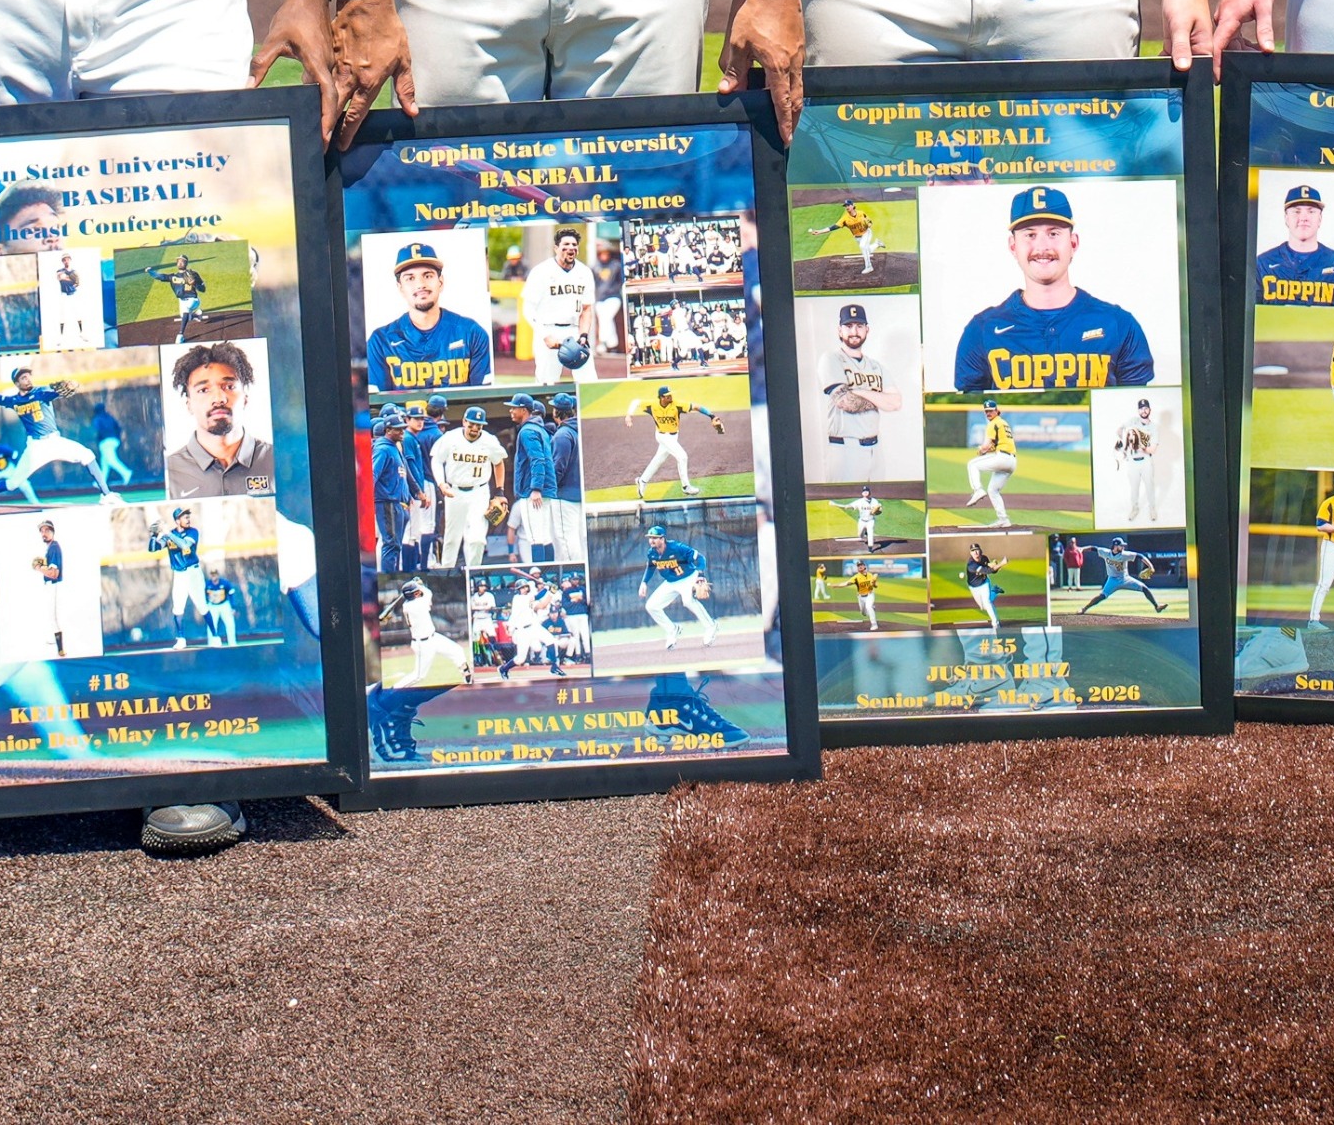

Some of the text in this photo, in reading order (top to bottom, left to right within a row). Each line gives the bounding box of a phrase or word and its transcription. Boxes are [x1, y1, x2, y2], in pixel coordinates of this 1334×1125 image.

[837, 98, 1126, 125] Coppin State University
[915, 127, 1052, 148] BASEBALL
[399, 134, 690, 167] Coppin State University
[26, 159, 90, 180] State
[99, 151, 230, 175] University
[480, 166, 618, 189] BASEBALL
[853, 157, 1115, 177] Northeast Conference
[62, 182, 203, 207] BASEBALL
[416, 195, 684, 220] Northeast Conference
[78, 212, 223, 235] Conference
[1263, 275, 1334, 304] COPPIN
[385, 355, 471, 388] COPPIN
[987, 348, 1111, 390] COPPIN
[980, 638, 1017, 654] #55
[90, 674, 129, 690] #18
[927, 662, 1069, 682] JUSTIN RITZ
[556, 688, 593, 704] #11
[856, 685, 1141, 710] Senior Day May 16, 2026
[10, 694, 211, 725] KEITH WALLACE
[477, 709, 679, 736] PRANAV SUNDAR
[49, 733, 101, 754] Day,
[108, 723, 154, 748] May
[166, 722, 198, 744] 17,
[205, 717, 259, 737] 2025
[432, 733, 725, 764] Senior Day May 16, 2026
